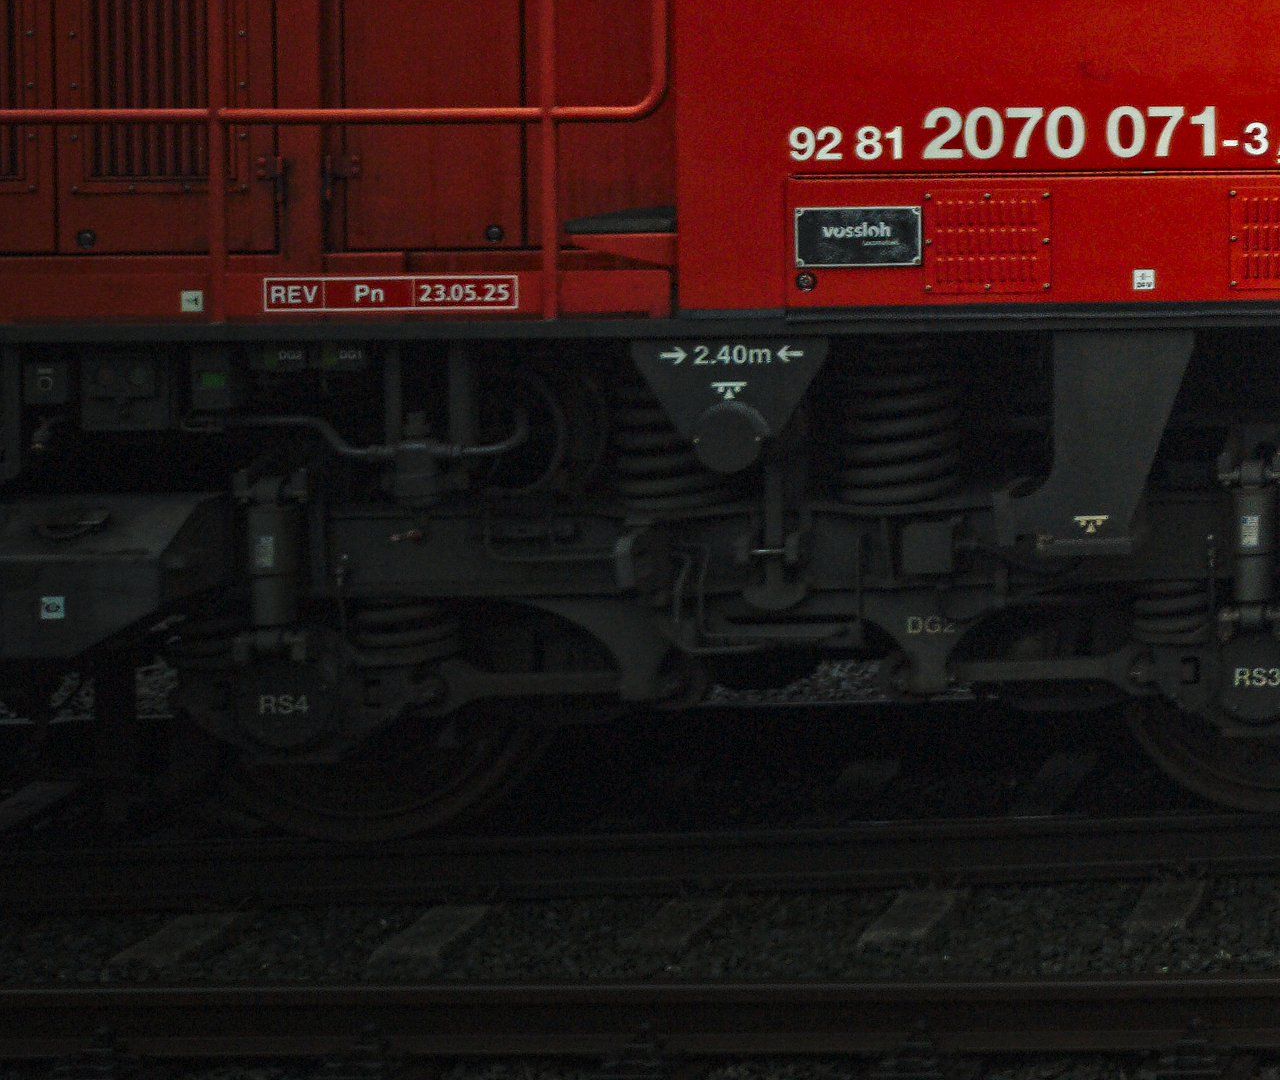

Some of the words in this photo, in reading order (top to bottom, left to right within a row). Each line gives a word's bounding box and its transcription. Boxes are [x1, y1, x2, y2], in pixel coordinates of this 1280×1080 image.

[788, 126, 842, 161] 92
[854, 126, 904, 161] 81
[922, 106, 1086, 160] 2070
[821, 222, 892, 239] vossloh
[270, 285, 318, 304] REV
[354, 284, 385, 302] Pn
[419, 283, 510, 303] 23.05.25
[693, 345, 772, 365] 2.40m
[1233, 667, 1280, 687] RS3
[258, 694, 310, 715] RS4
